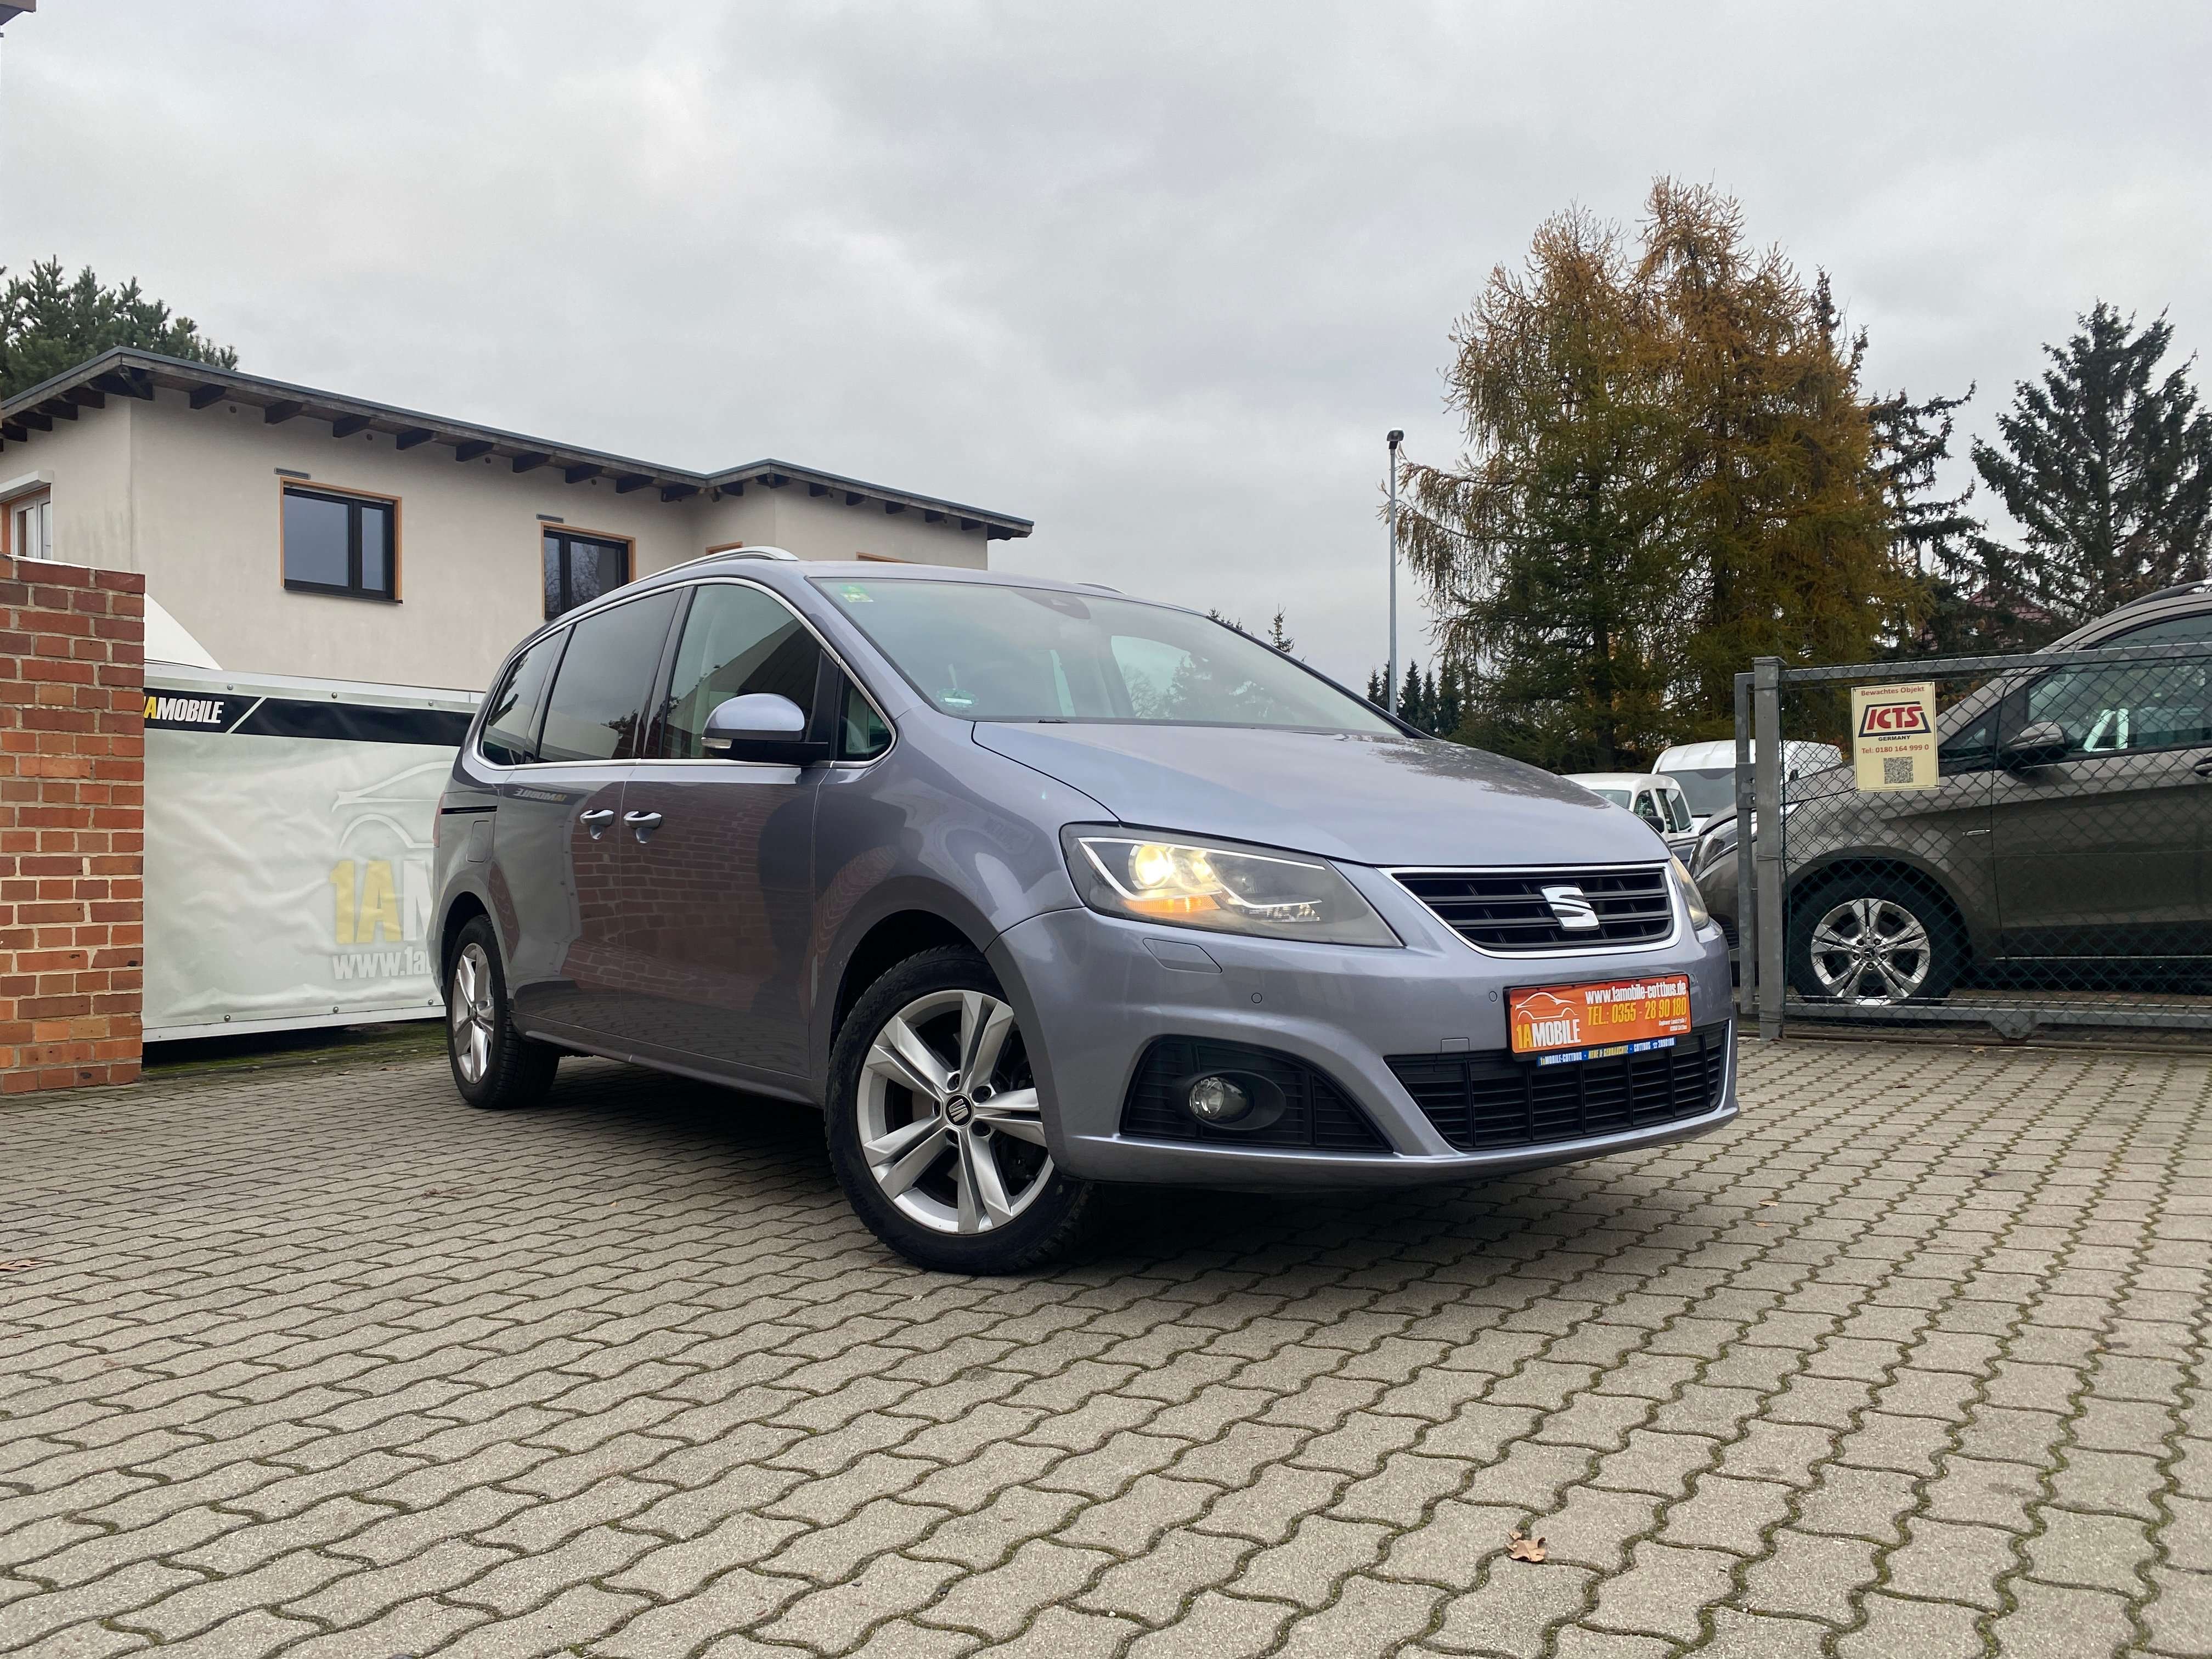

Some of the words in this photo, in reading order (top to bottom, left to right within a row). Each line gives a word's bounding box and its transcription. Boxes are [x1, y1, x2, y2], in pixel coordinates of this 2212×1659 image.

[1861, 687, 1899, 696] Bewachtes
[1900, 686, 1925, 694] Objekt
[143, 695, 224, 724] AMOBILE
[1867, 706, 1923, 731] ICTS
[1585, 979, 1686, 1005] www.1amobile-cottbus.de
[1612, 1002, 1637, 1023] 0355
[1645, 1000, 1656, 1020] 28
[1658, 998, 1670, 1018] 90
[1672, 996, 1687, 1017] 180
[1516, 1019, 1581, 1049] 1AMOBILE
